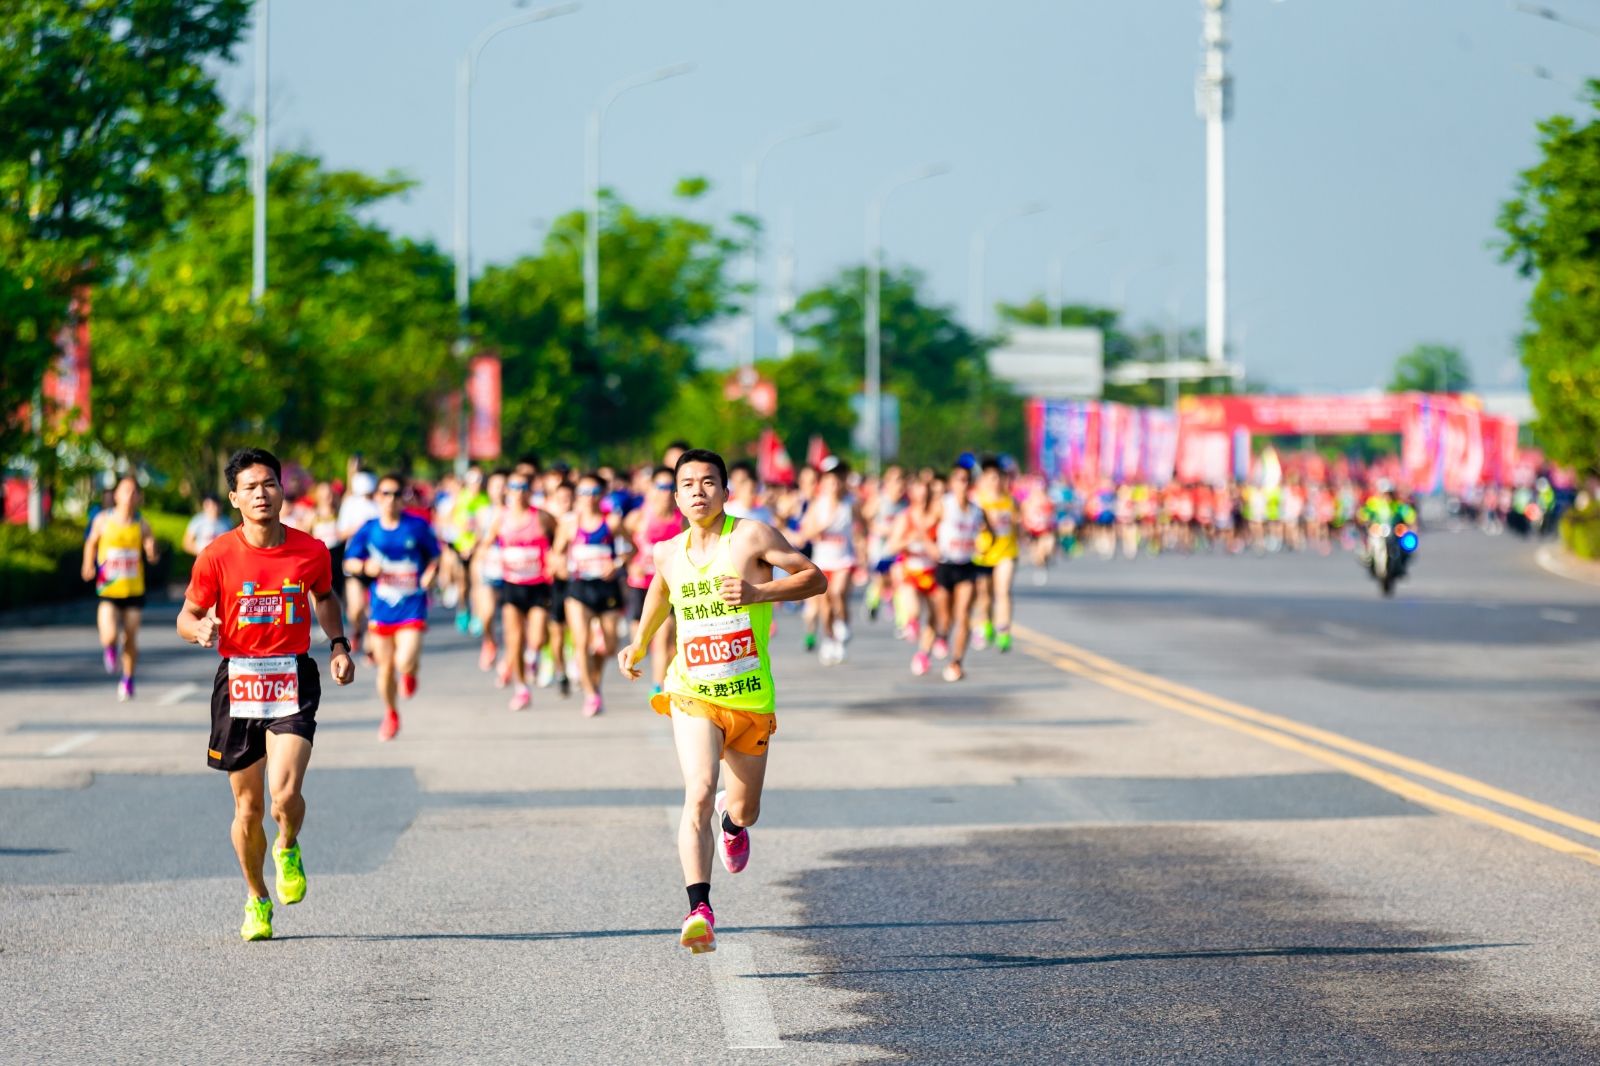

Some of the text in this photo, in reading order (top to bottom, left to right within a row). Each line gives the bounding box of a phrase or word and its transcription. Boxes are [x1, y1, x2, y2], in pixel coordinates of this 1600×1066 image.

[258, 596, 282, 605] 2021
[687, 636, 752, 664] C10367
[231, 680, 294, 699] C10764
[698, 676, 760, 697] 免费评估
